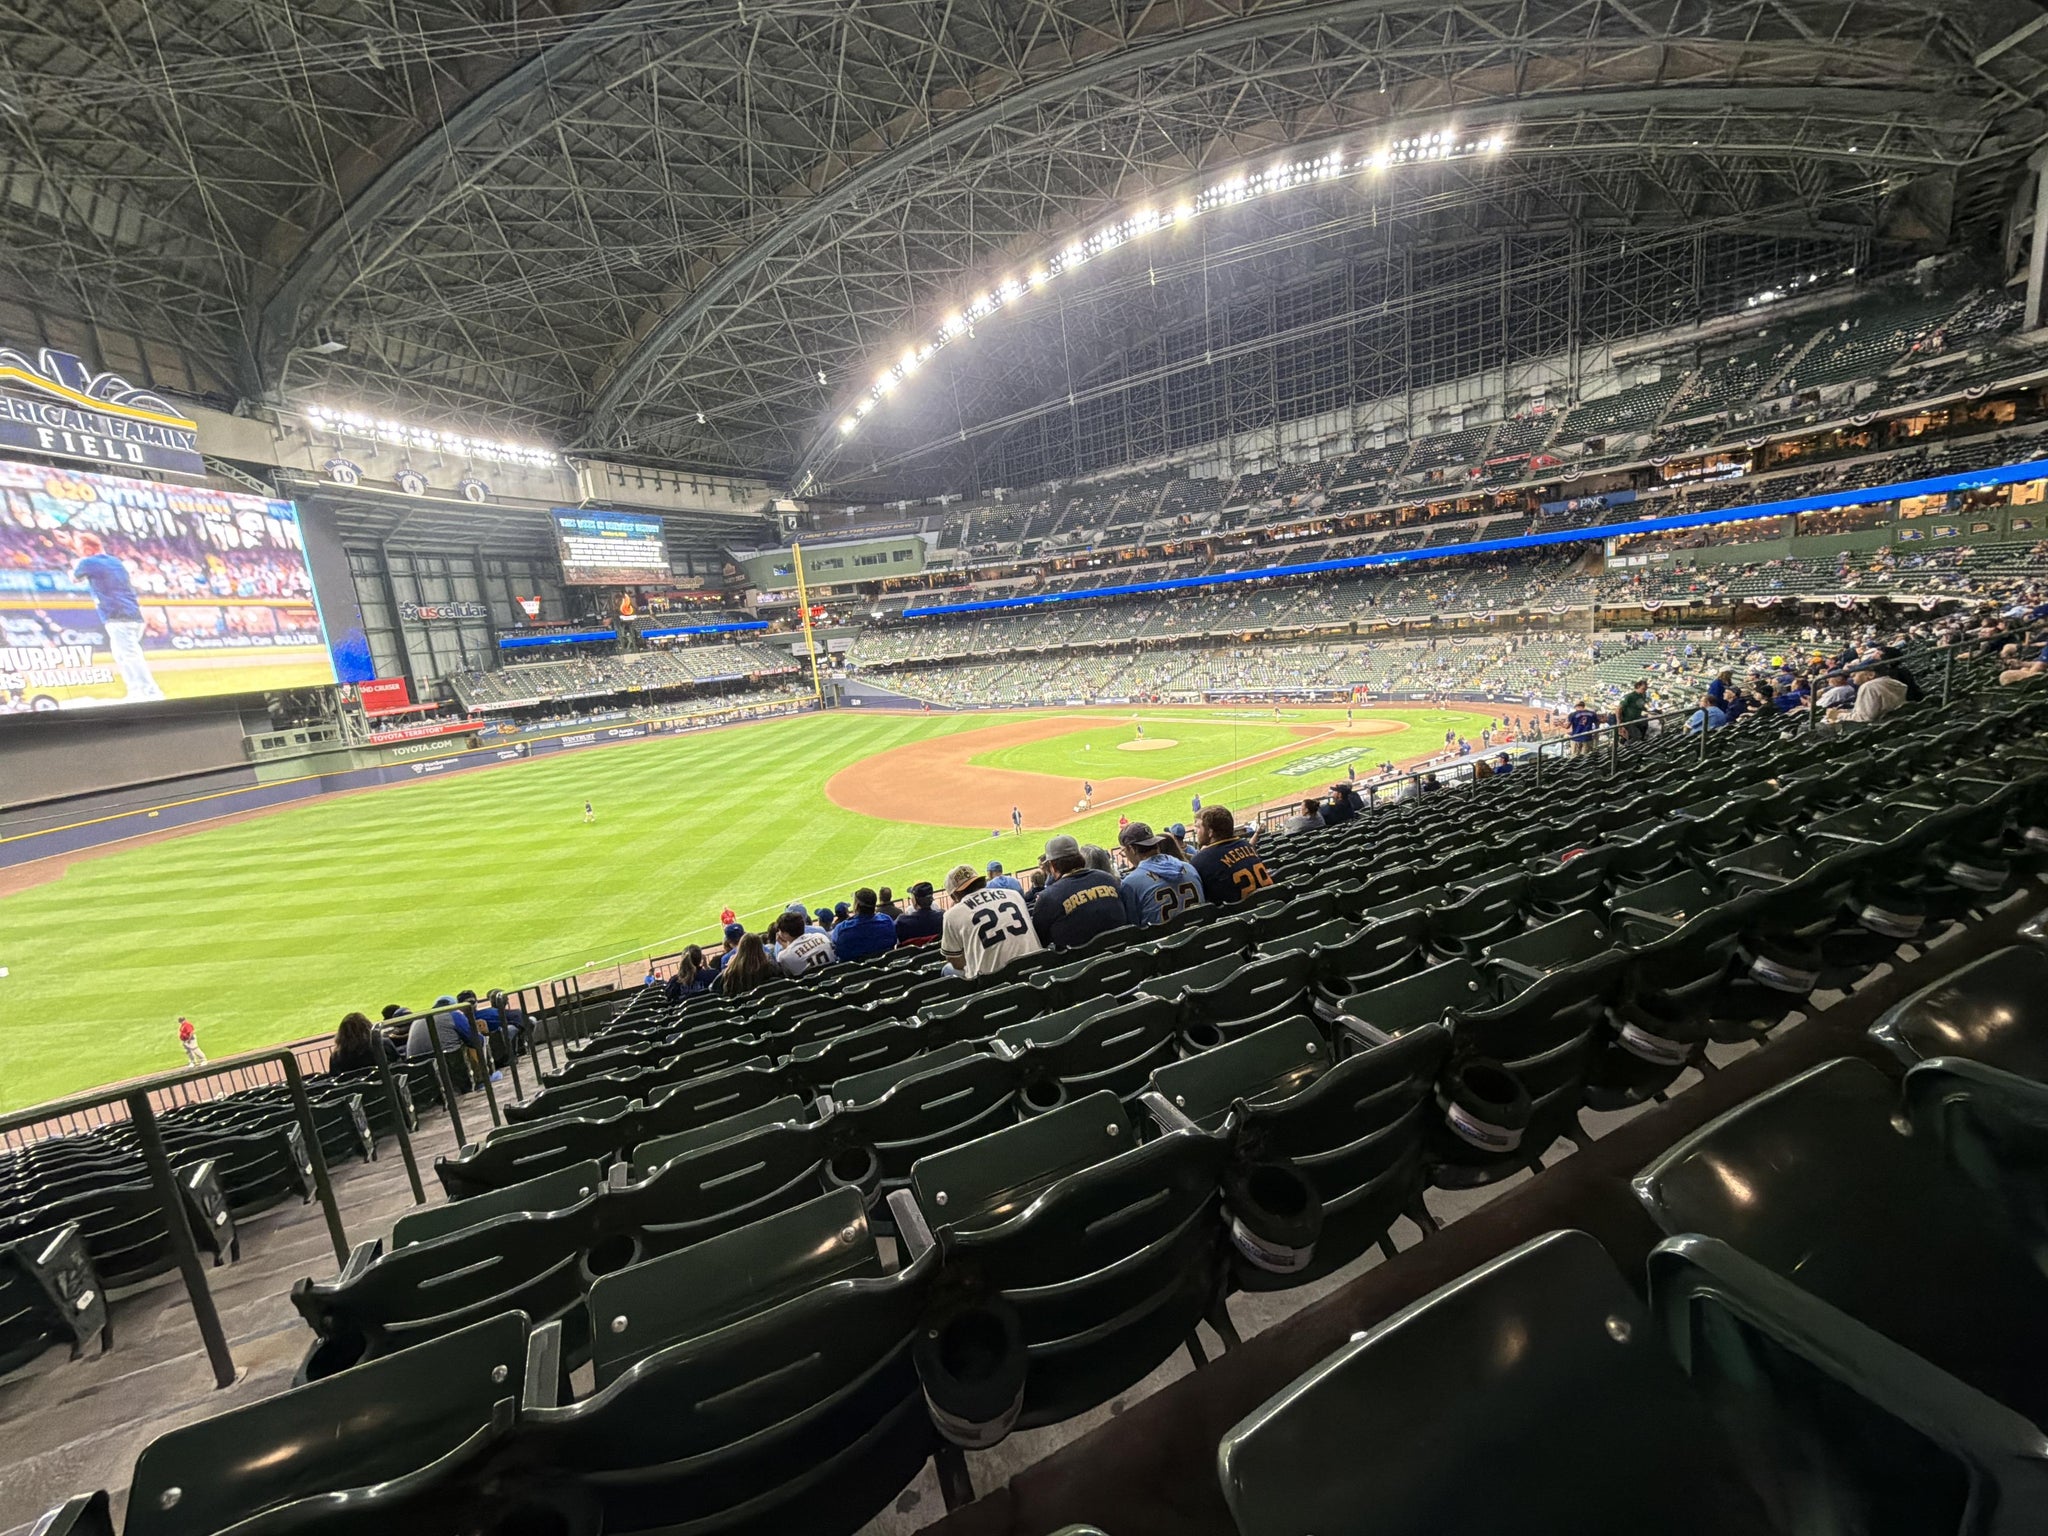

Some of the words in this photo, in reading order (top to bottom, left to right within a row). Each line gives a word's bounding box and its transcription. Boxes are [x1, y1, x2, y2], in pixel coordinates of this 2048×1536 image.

[106, 416, 198, 451] FAMILY
[37, 428, 144, 463] FIELD
[336, 470, 354, 484] 19
[408, 479, 417, 493] 4
[45, 478, 97, 502] 620
[28, 668, 116, 688] MANAGER
[374, 683, 401, 692] CRUISER
[373, 732, 404, 743] TOYOTA
[403, 727, 444, 738] TERRITORY
[392, 739, 453, 757] TOYOTA.COM
[963, 890, 1008, 910] WEEKS
[1062, 885, 1119, 916] BREWERS
[971, 901, 1029, 950] 23
[794, 937, 826, 958] FRELICK
